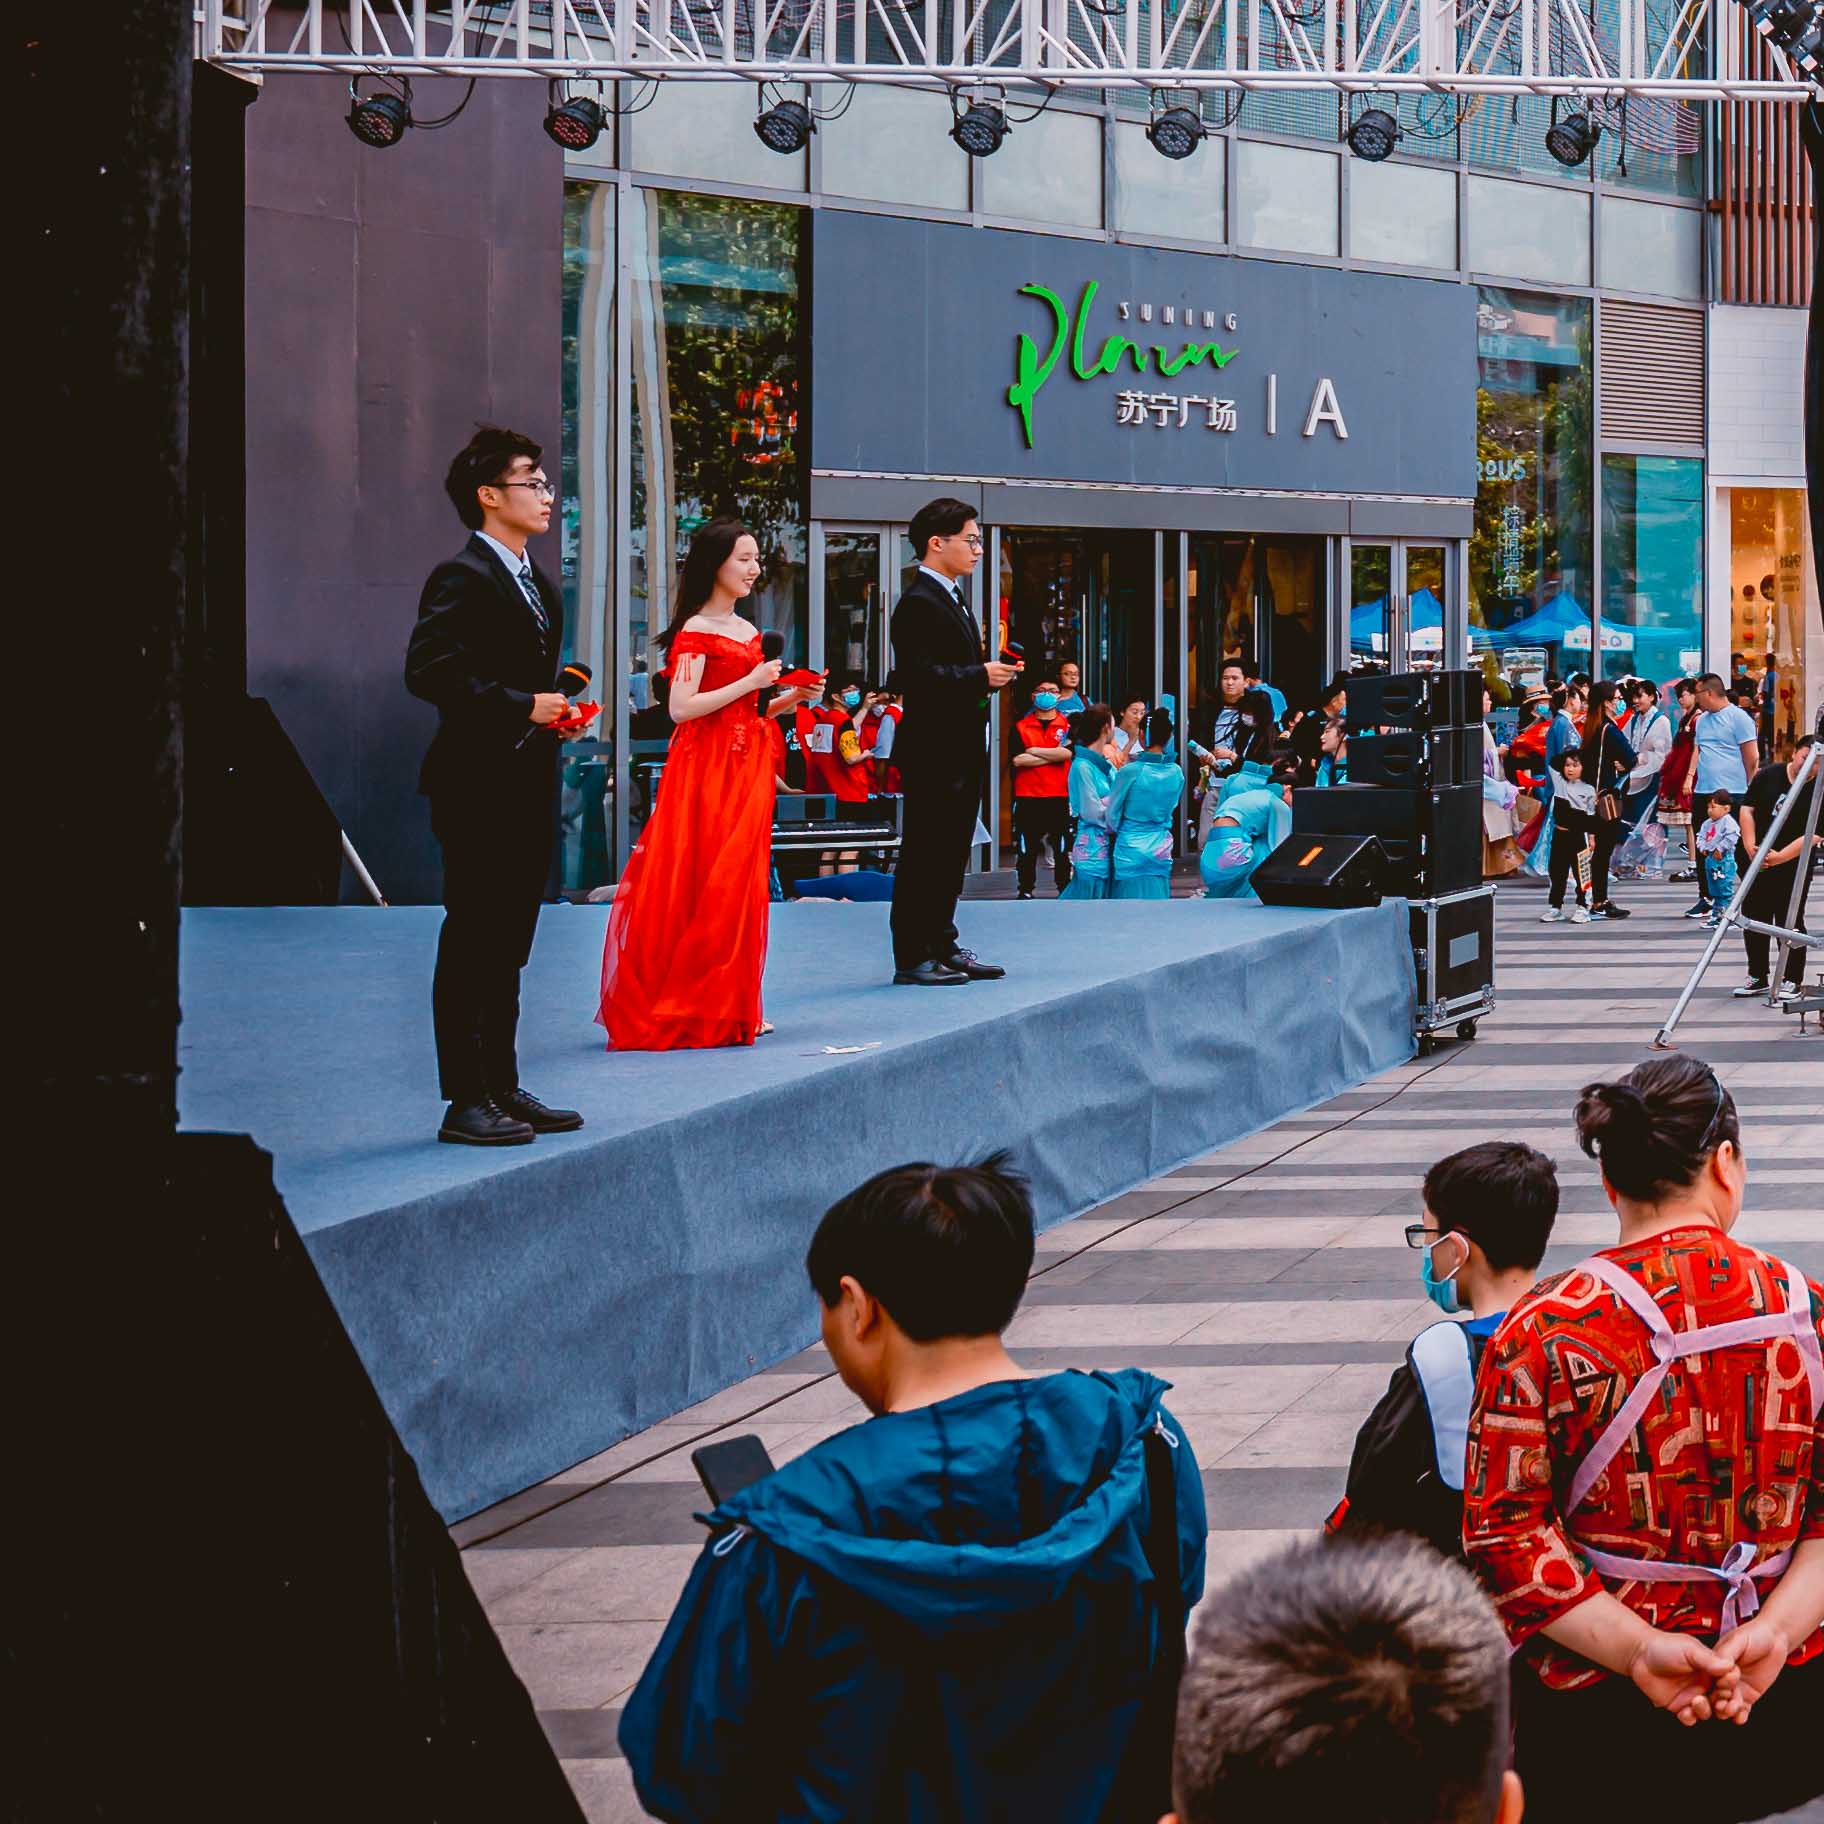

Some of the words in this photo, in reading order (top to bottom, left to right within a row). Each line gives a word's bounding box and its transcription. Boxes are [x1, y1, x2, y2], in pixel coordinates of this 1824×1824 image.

[1118, 301, 1239, 331] SUNING
[1116, 389, 1238, 433] 苏宁广场
[1302, 377, 1349, 439] A
